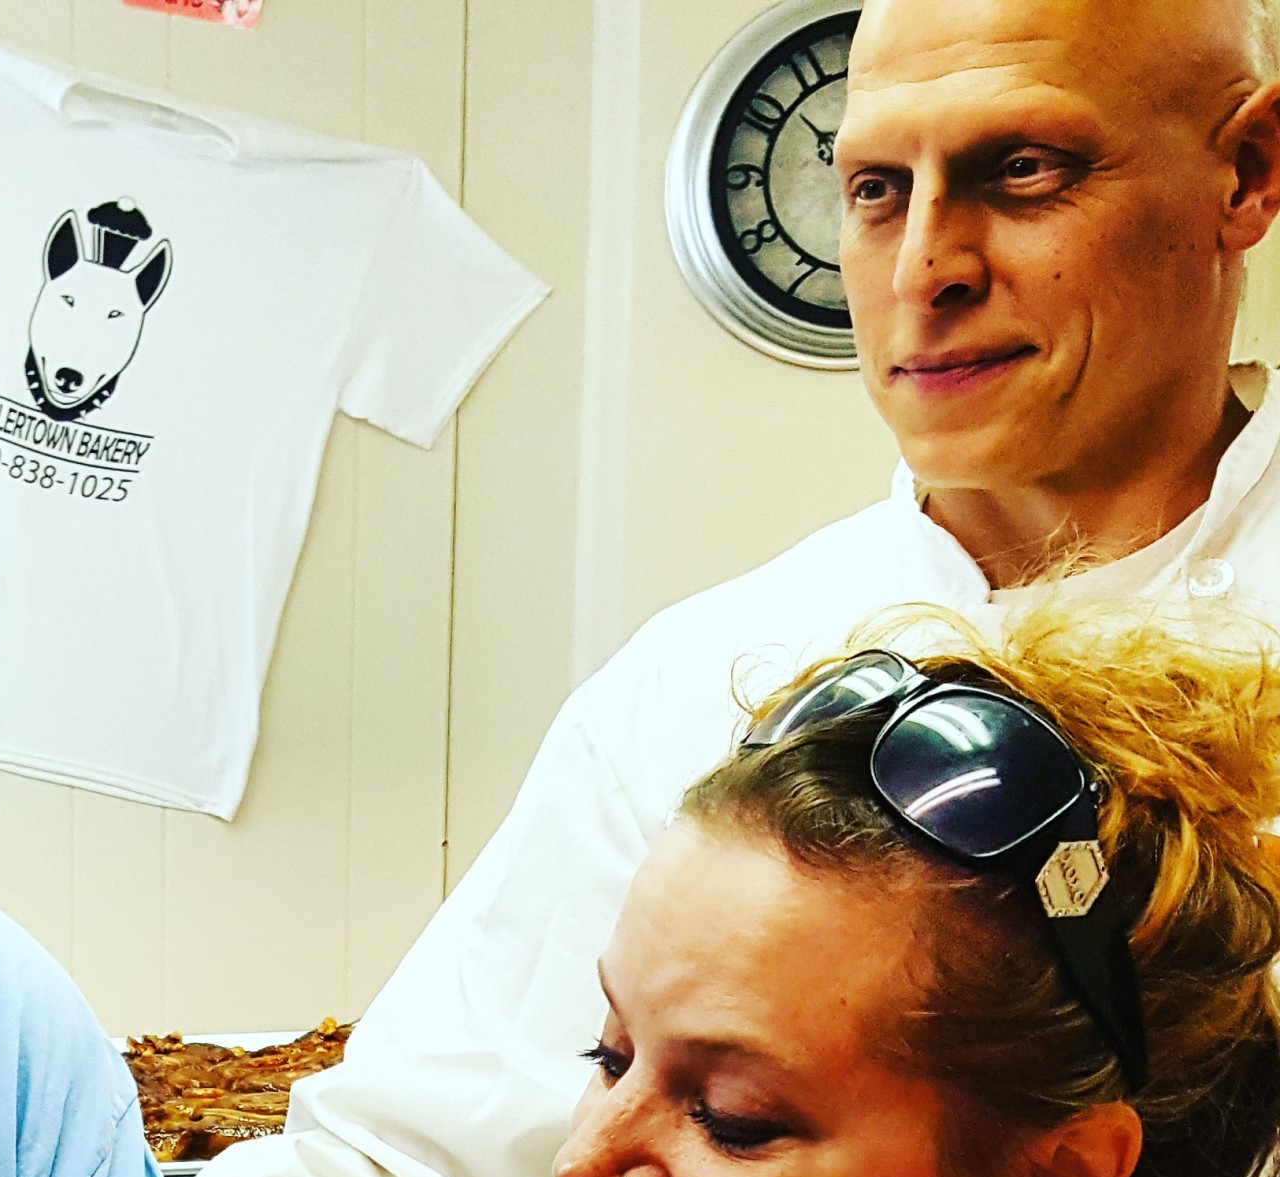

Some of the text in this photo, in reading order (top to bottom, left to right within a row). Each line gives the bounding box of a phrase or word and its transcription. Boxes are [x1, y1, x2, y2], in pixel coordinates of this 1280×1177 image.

[742, 91, 786, 134] 10
[738, 218, 780, 255] 8
[75, 430, 152, 466] BAKERY
